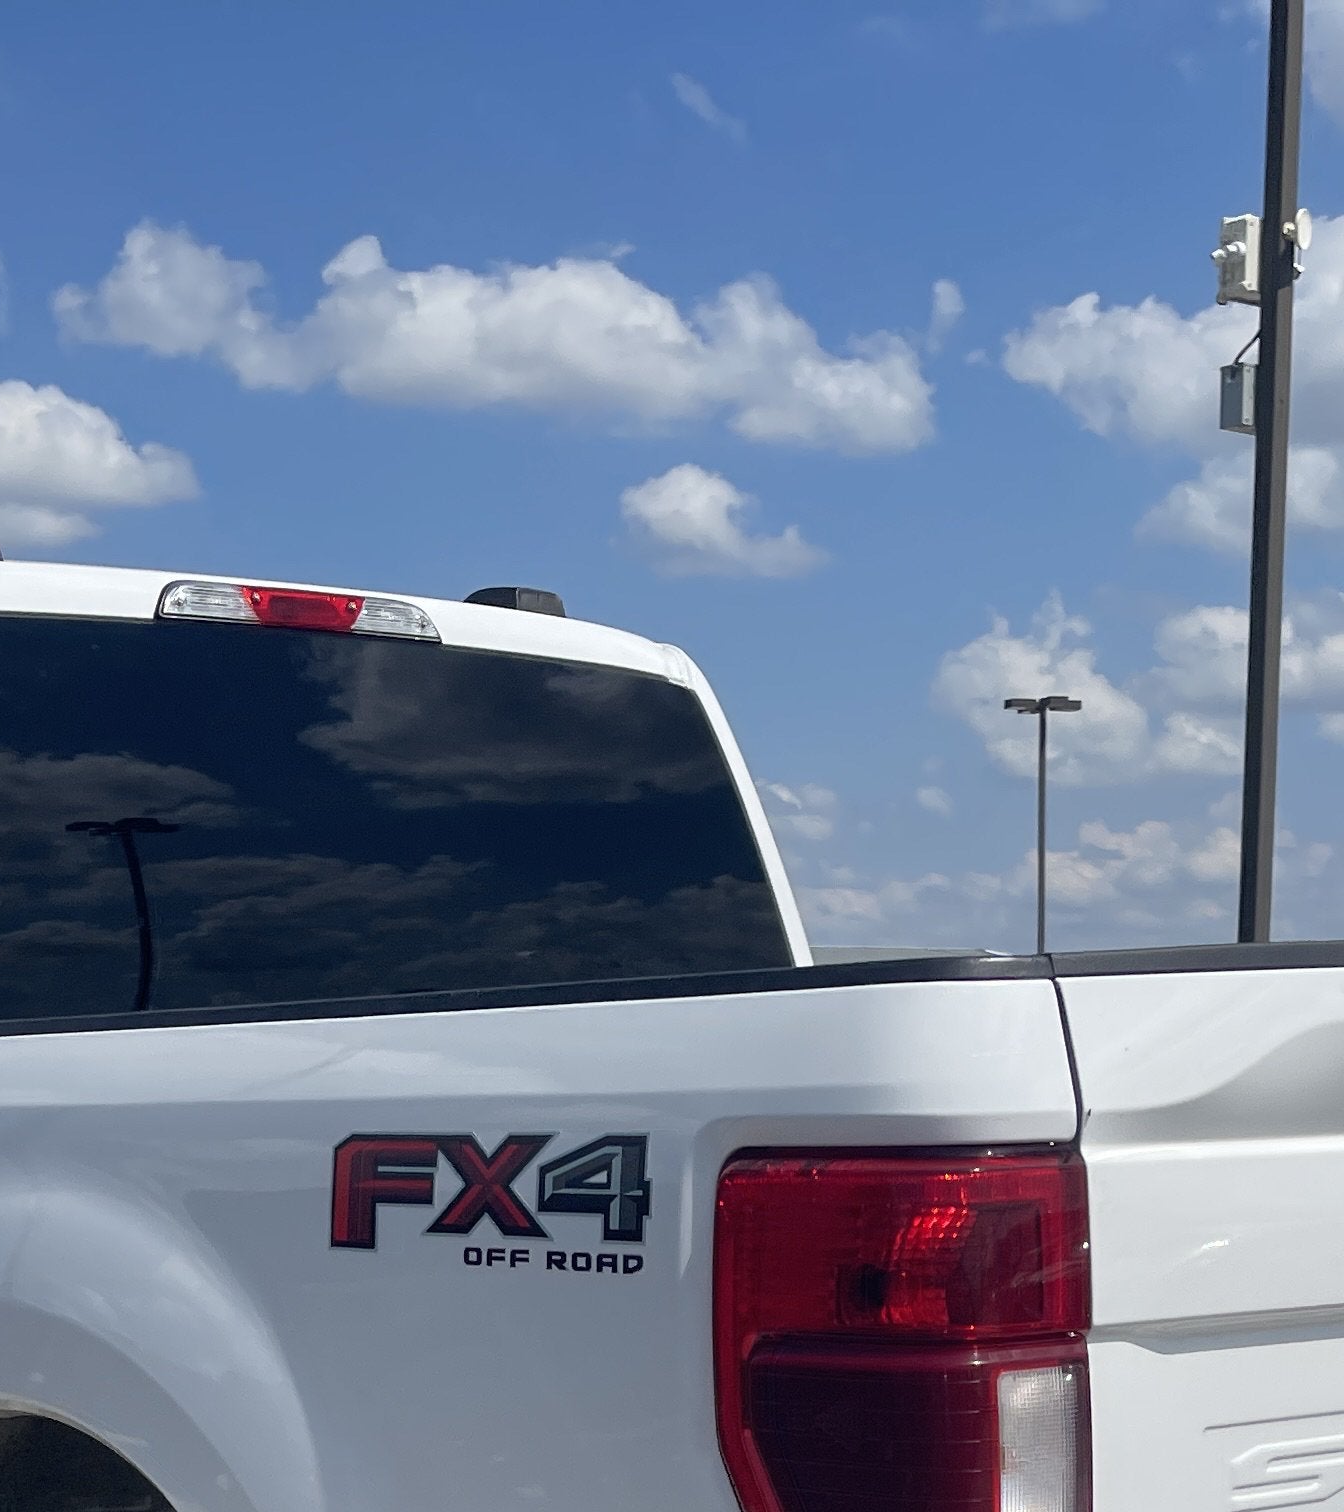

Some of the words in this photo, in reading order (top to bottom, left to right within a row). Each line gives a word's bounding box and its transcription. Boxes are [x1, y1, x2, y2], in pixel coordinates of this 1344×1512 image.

[330, 1132, 652, 1251] FX4
[463, 1246, 531, 1268] OFF
[545, 1250, 644, 1275] ROAD
